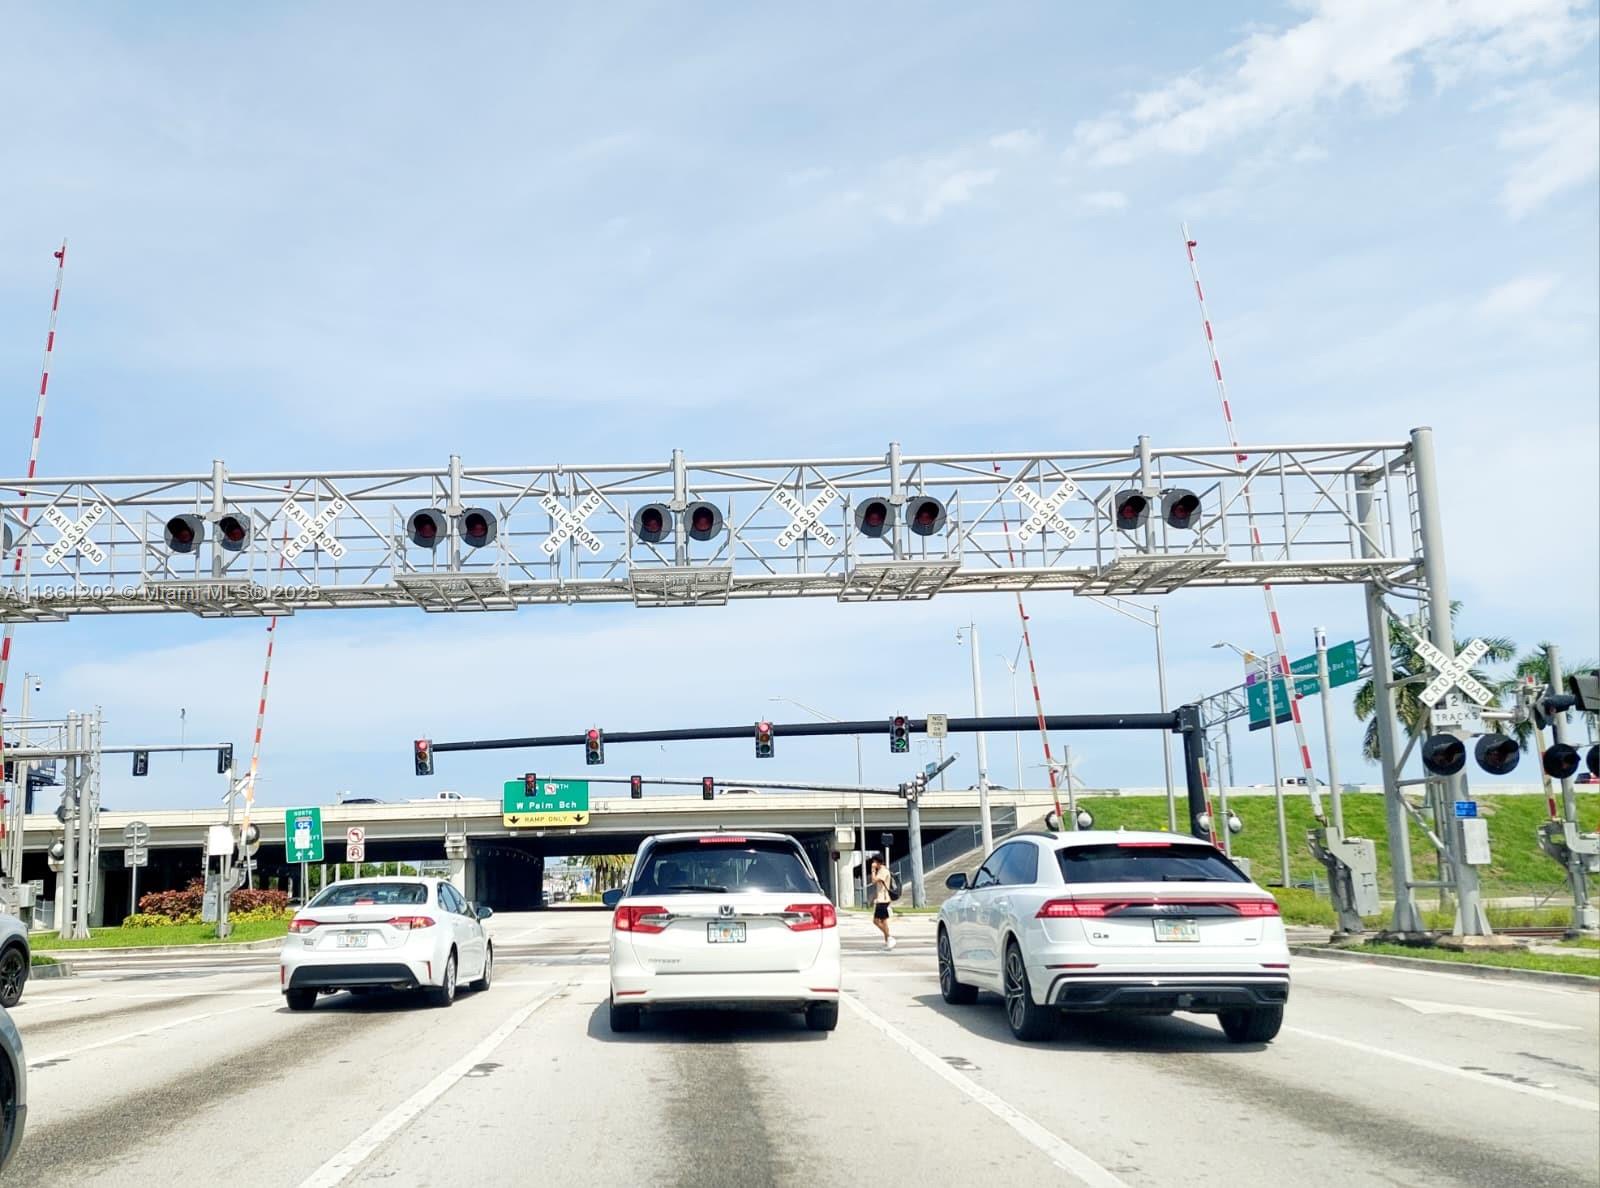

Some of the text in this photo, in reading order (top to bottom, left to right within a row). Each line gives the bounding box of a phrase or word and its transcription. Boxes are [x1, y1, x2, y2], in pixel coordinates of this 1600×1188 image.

[46, 505, 103, 564] CROSSING
[285, 500, 343, 559] CROSSING
[543, 495, 600, 553] CROSSING
[778, 489, 835, 547] CROSSING
[1018, 483, 1074, 541] CROSSING
[1423, 641, 1485, 703] CROSSING
[1450, 695, 1459, 707] 2
[1436, 711, 1478, 721] TRACKS
[298, 821, 310, 830] 95
[516, 800, 577, 810] W Palm Bch
